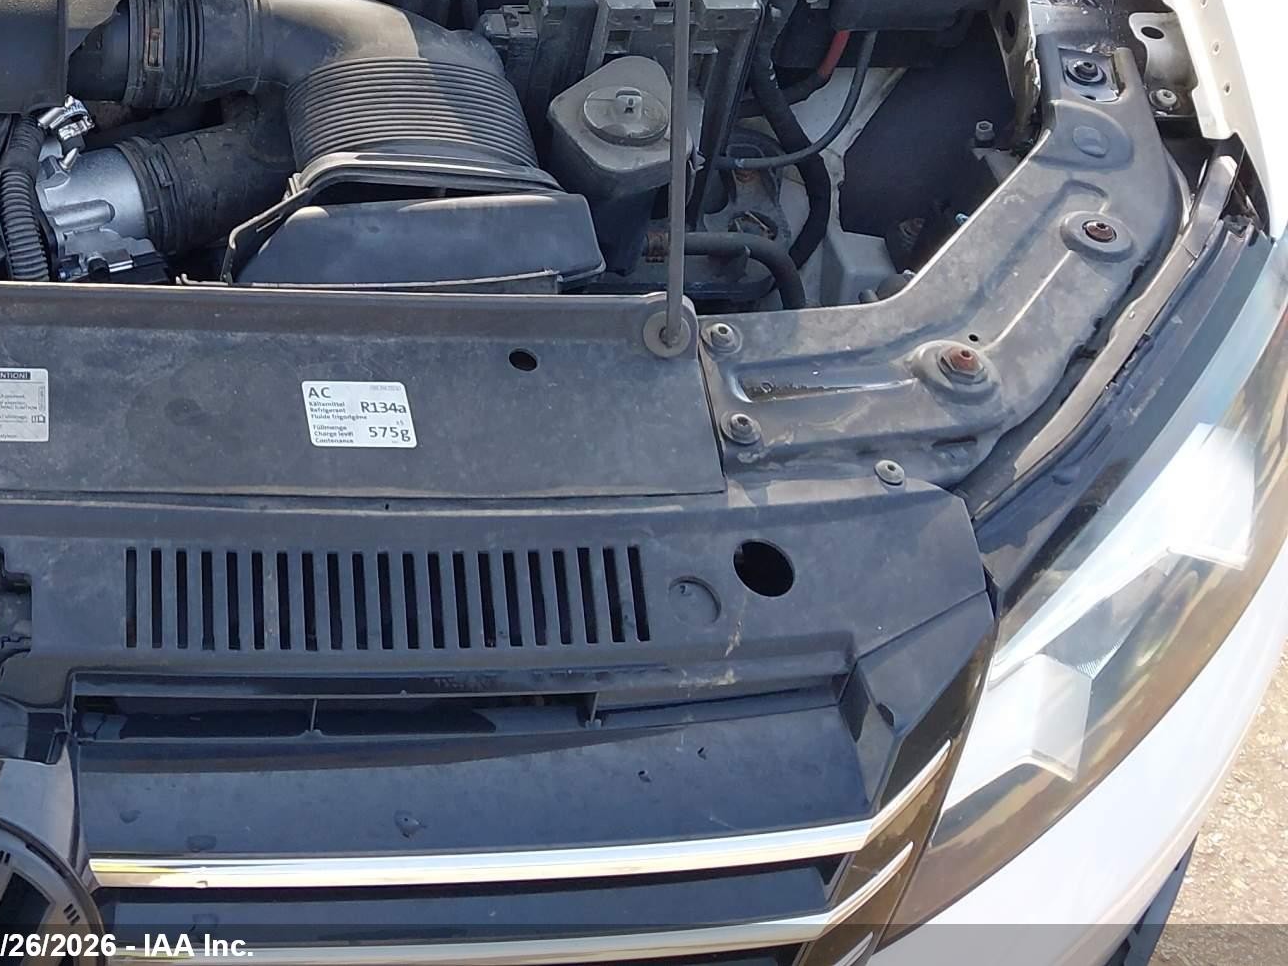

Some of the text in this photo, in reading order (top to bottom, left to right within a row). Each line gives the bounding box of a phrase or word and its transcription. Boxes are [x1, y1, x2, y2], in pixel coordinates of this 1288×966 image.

[308, 386, 332, 399] AC
[360, 401, 407, 414] R134a
[368, 426, 412, 443] 575g
